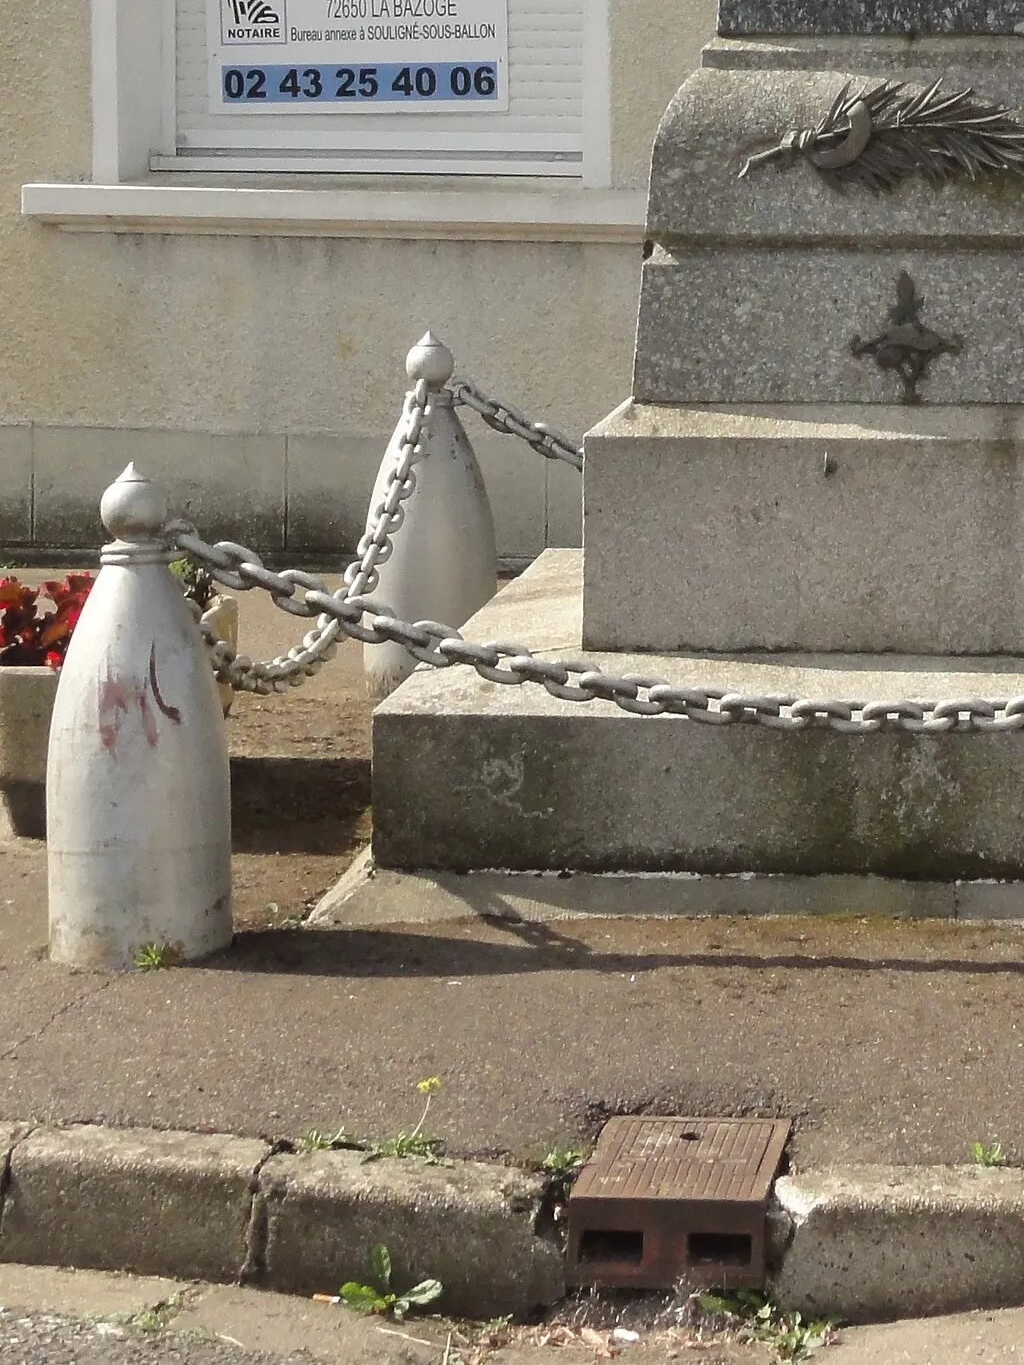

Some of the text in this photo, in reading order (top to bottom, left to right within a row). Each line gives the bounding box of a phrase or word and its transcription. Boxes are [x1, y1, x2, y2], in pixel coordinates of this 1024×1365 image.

[228, 27, 280, 39] NOTAIRE
[290, 22, 496, 42] Bureau annexe à SOULIGNÉ-SOUS-BALLON
[224, 65, 496, 100] 02 43 25 40 06
